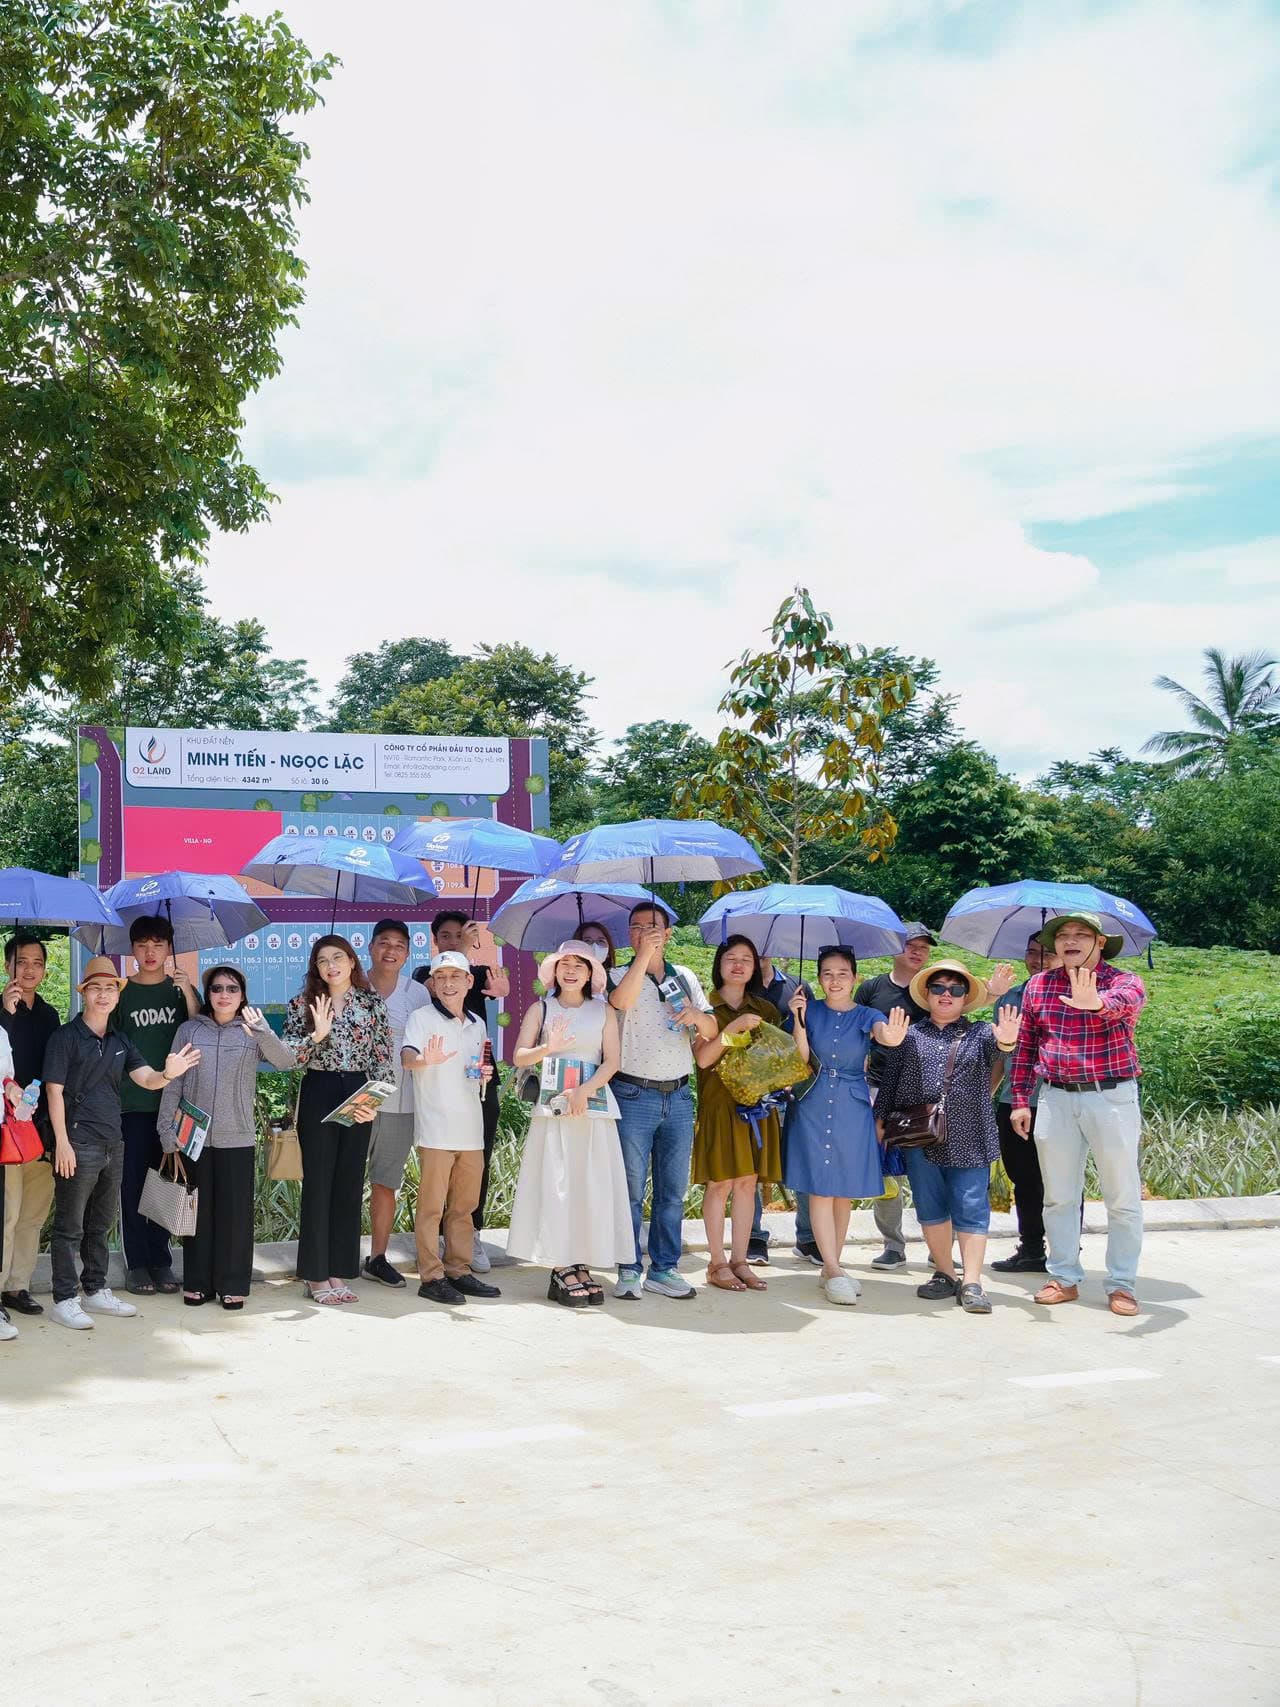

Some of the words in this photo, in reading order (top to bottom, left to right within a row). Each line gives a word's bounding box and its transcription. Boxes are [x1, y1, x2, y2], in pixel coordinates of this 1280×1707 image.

[186, 737, 202, 745] KHU
[383, 743, 406, 751] CÔNG
[485, 746, 503, 754] LAND
[187, 751, 229, 767] MINH
[234, 748, 266, 767] TIẾN
[280, 754, 329, 772] NGỌC
[334, 753, 364, 773] LẶC
[132, 766, 145, 775] O2
[147, 767, 171, 775] LAND
[241, 776, 260, 784] 4342
[311, 777, 320, 785] 30
